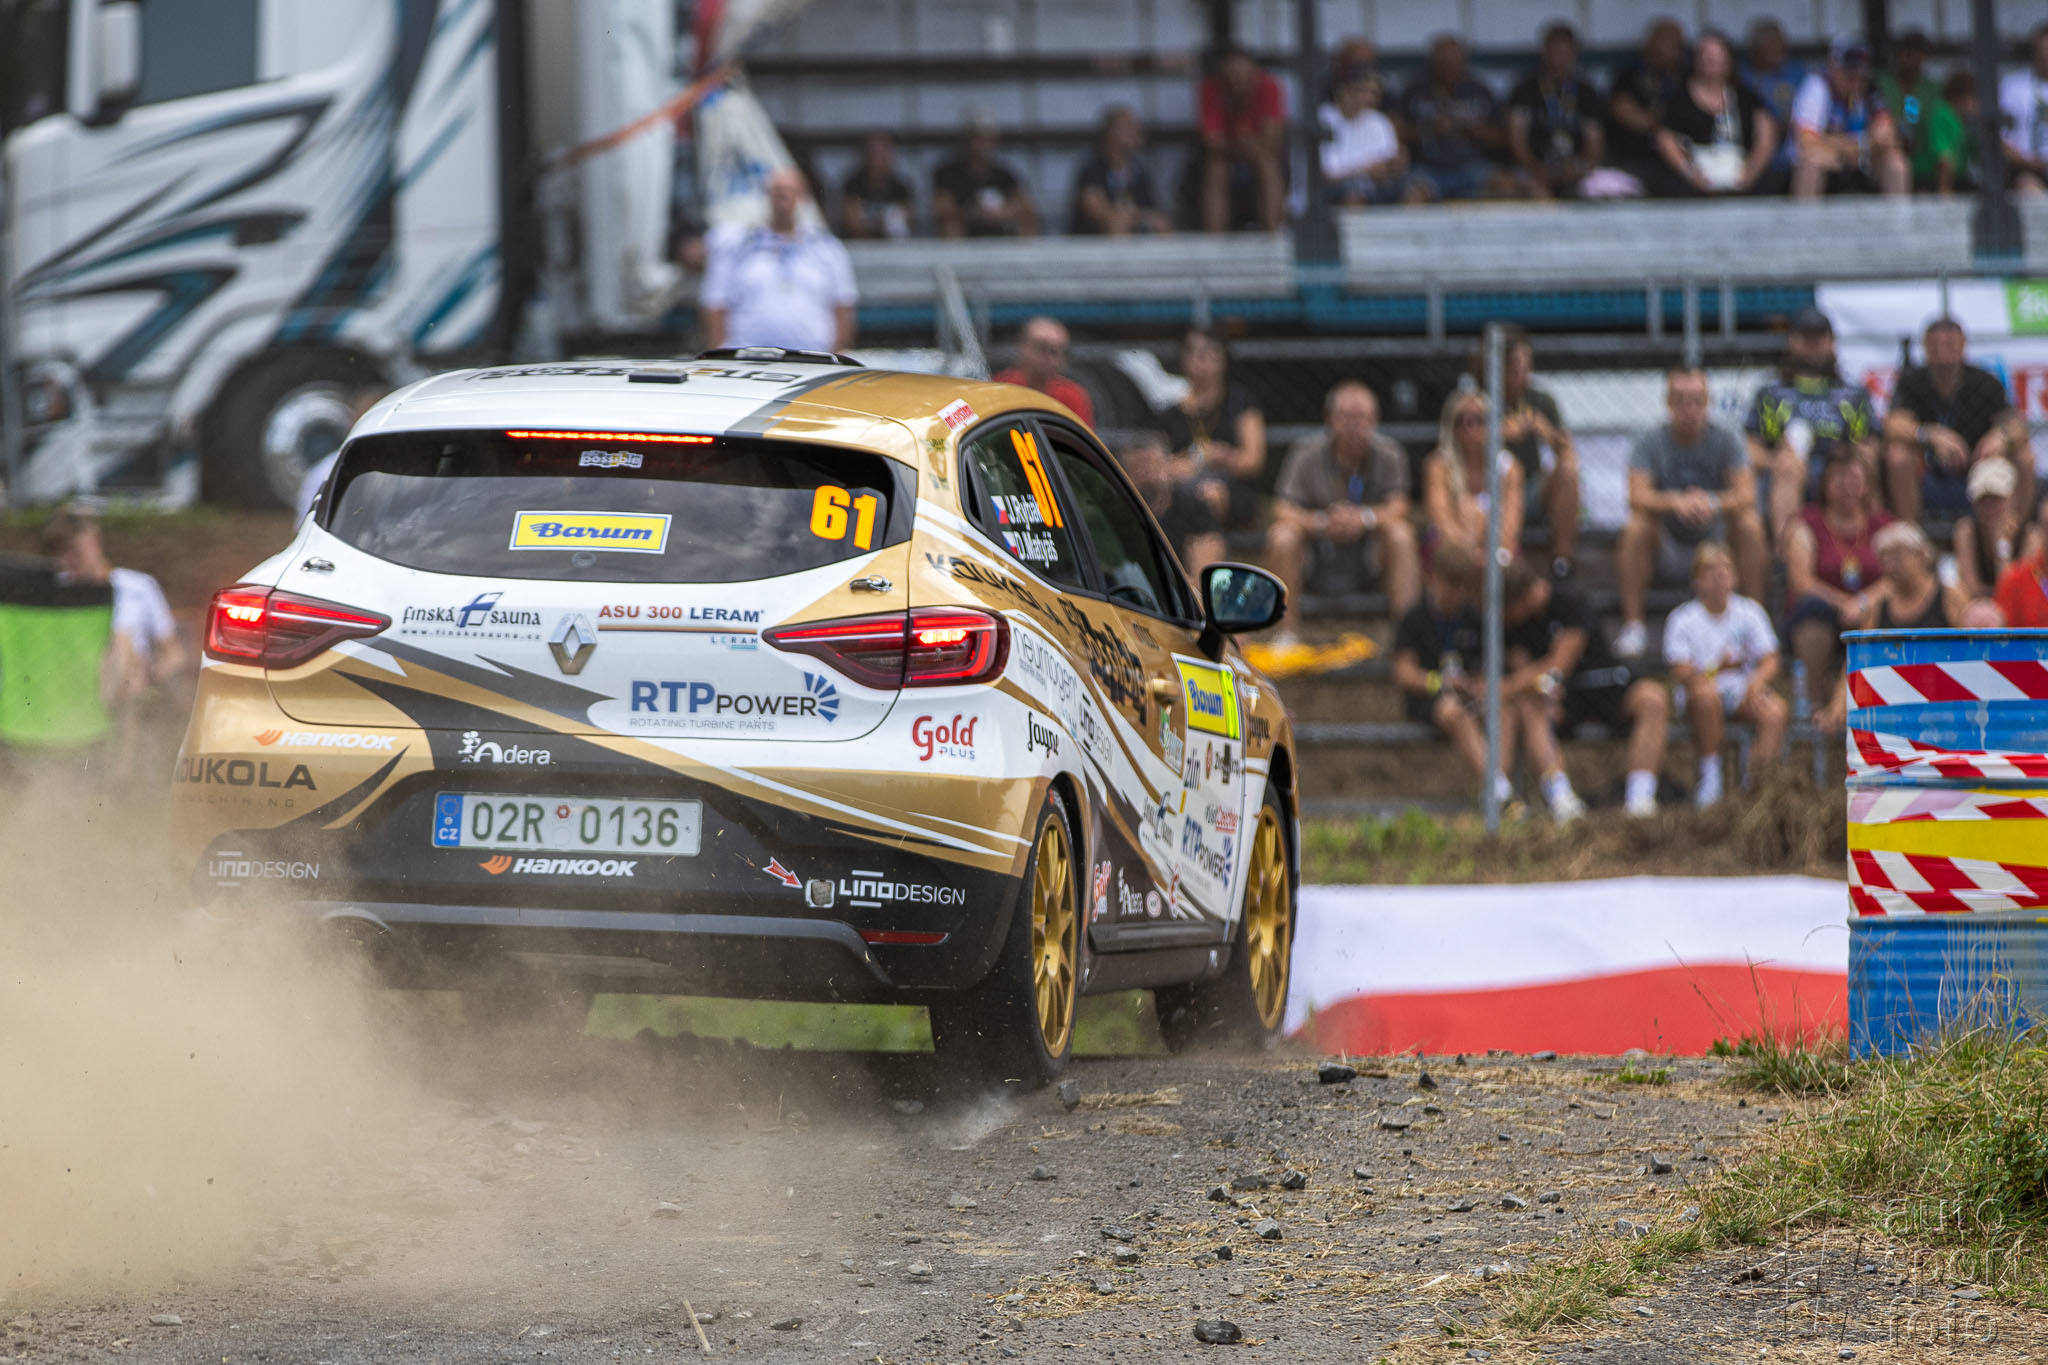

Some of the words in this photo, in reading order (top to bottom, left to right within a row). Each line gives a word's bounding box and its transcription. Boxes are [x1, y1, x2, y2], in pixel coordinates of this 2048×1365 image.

[810, 485, 877, 549] 61
[530, 522, 653, 540] Barum
[402, 605, 455, 625] finská
[489, 610, 541, 626] sauna
[599, 605, 640, 619] ASU
[647, 606, 682, 620] 300
[631, 680, 716, 713] RTP
[716, 694, 817, 716] POWER
[1187, 678, 1224, 717] Barum
[630, 718, 687, 729] ROTATING
[690, 720, 736, 730] TURBINE
[739, 721, 775, 731] PARTS
[912, 714, 978, 761] Gold
[473, 745, 551, 764] Adera
[439, 829, 458, 840] CZ
[472, 801, 545, 843] 02R
[579, 805, 679, 847] 0136
